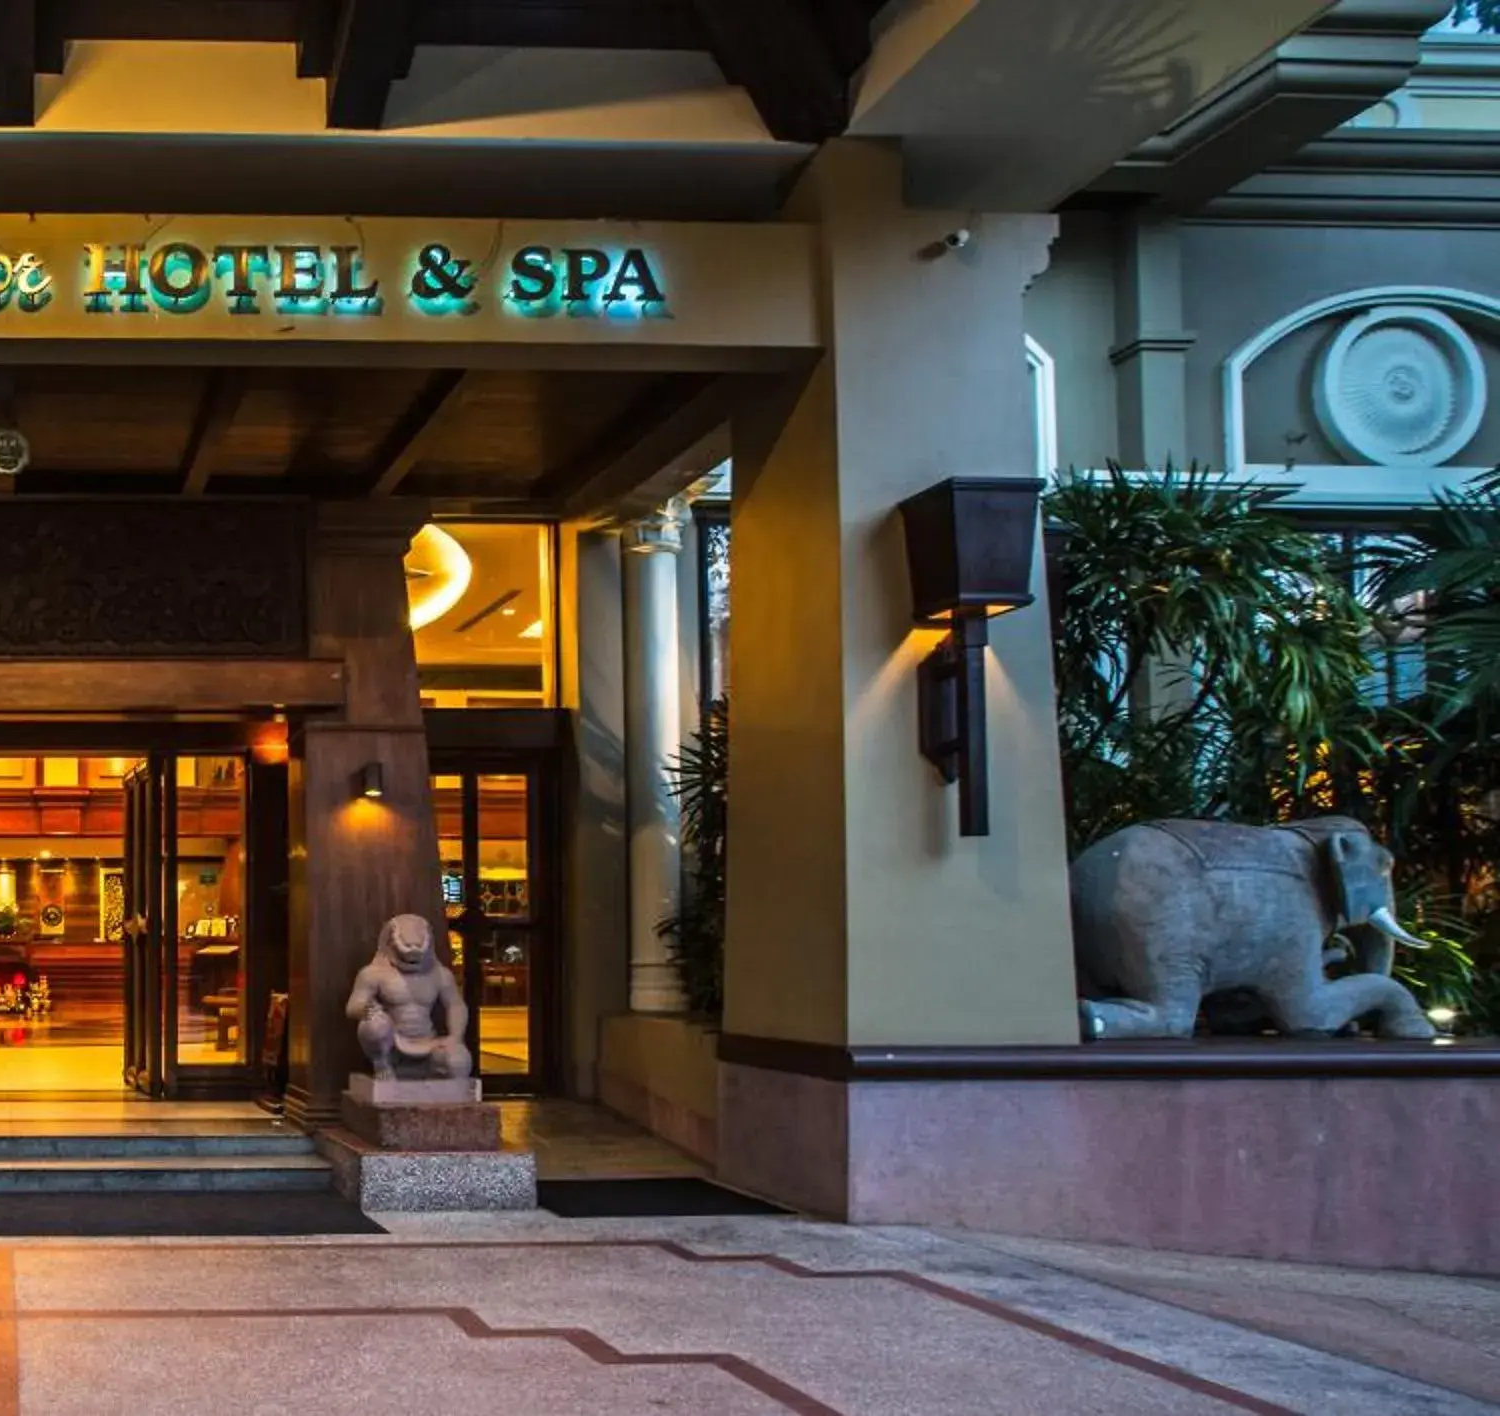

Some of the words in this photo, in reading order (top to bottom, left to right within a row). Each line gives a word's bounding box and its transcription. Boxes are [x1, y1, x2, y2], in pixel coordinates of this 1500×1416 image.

[84, 242, 381, 303] HOTEL
[409, 243, 476, 300] &
[508, 245, 668, 304] SPA
